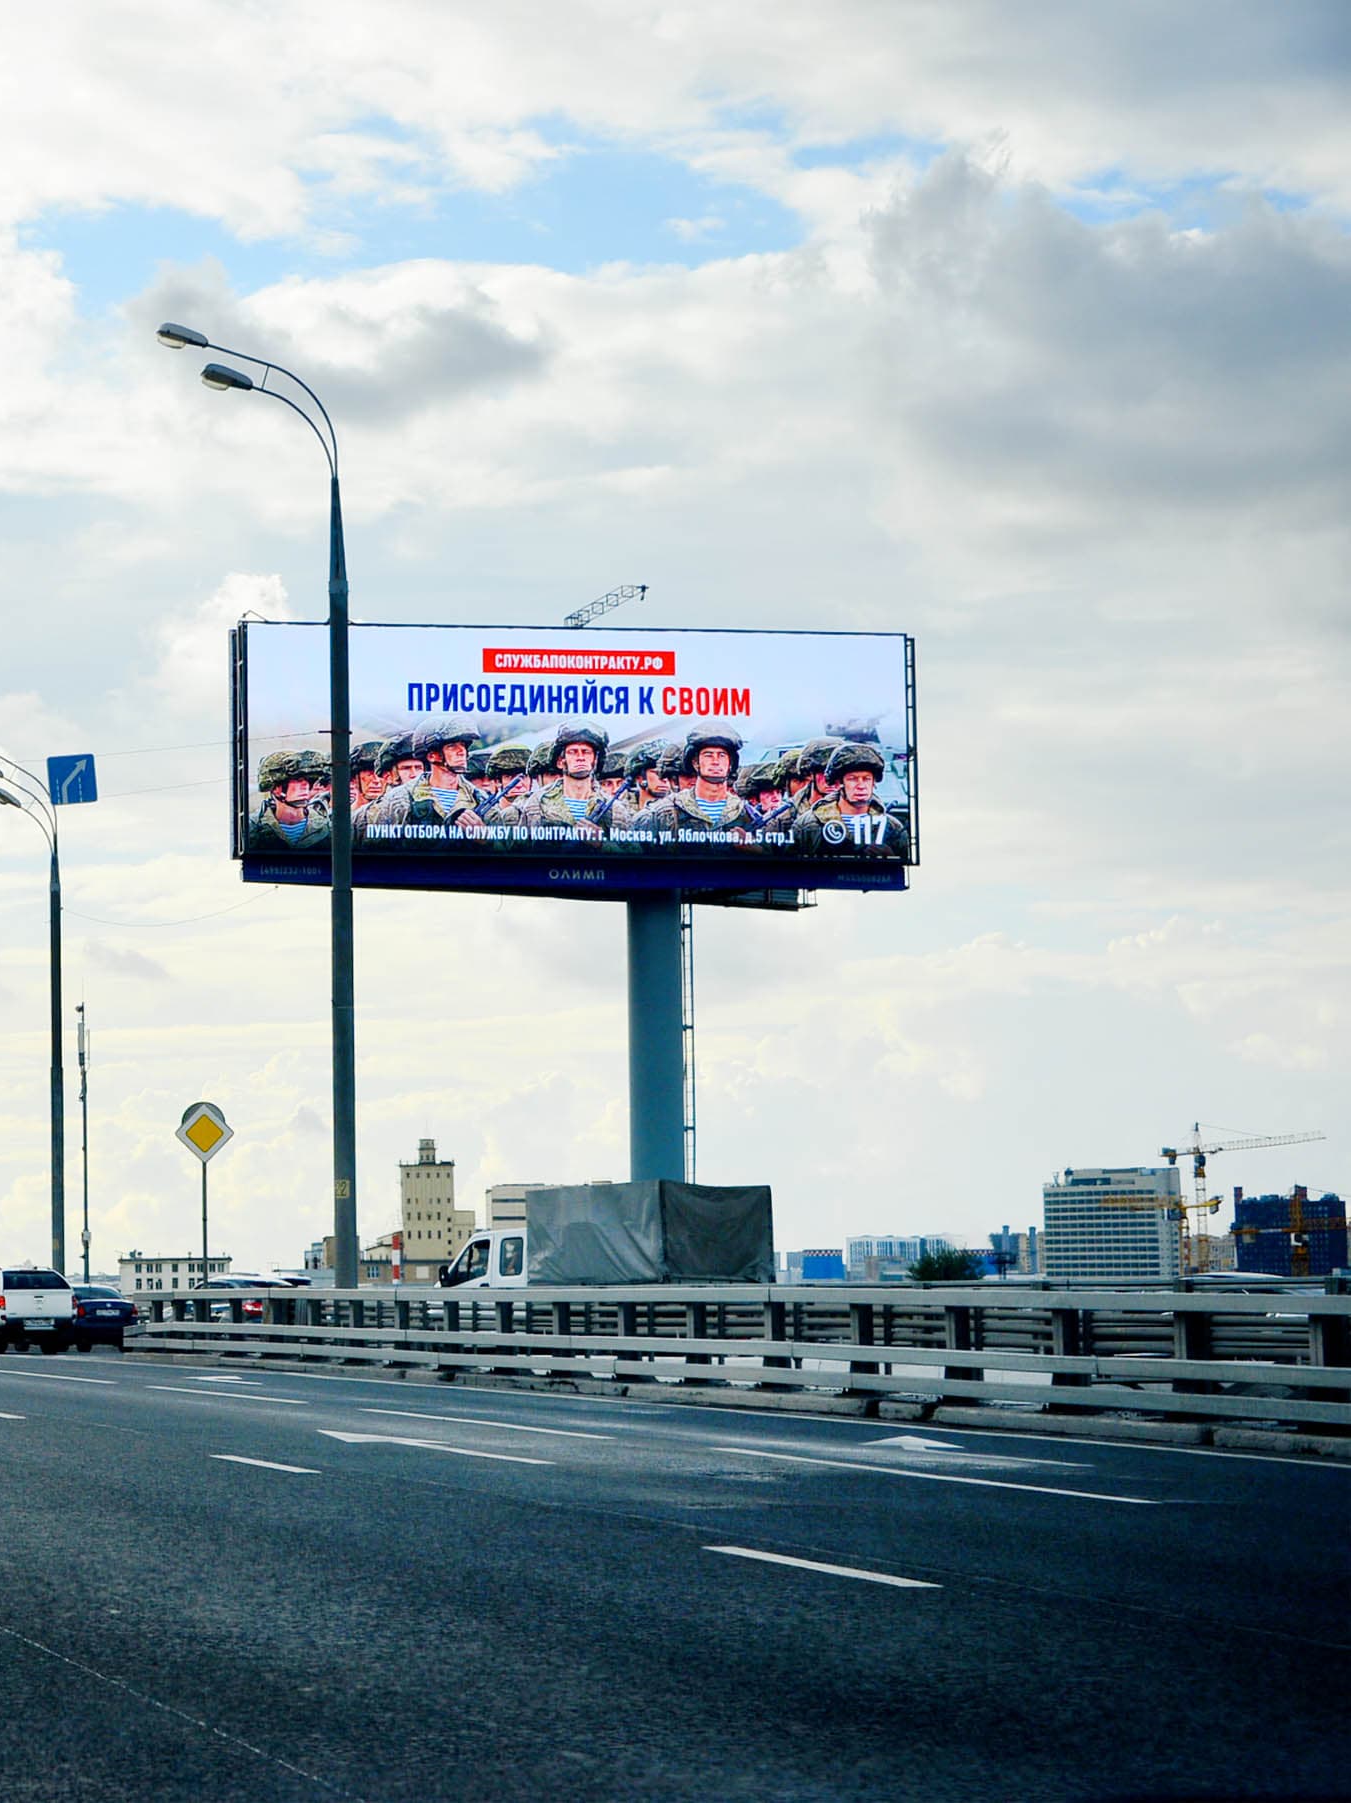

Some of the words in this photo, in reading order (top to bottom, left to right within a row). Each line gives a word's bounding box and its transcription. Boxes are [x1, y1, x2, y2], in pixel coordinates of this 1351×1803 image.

[495, 654, 663, 670] СЛУЖБАПОКОНТРАКТУ.РФ
[408, 679, 629, 716] ПРИСОЕДИНЯЙСЯ
[639, 687, 654, 714] К
[662, 687, 750, 716] СВОИМ
[367, 824, 401, 838] ПУНКТ
[405, 825, 447, 839] ОТБОРА
[449, 825, 463, 839] НА
[466, 825, 512, 840] СЛУЖБУ
[513, 826, 528, 840] ПО
[530, 826, 597, 841] КОНТРАКТУ:
[599, 830, 607, 841] г.
[610, 827, 657, 844] Москва,
[659, 832, 675, 845] ул.
[678, 828, 742, 845] Яблочкова,
[745, 830, 763, 845] д.5
[765, 830, 795, 846] стр.1
[852, 816, 888, 845] 117
[549, 869, 605, 880] ОЛИМП
